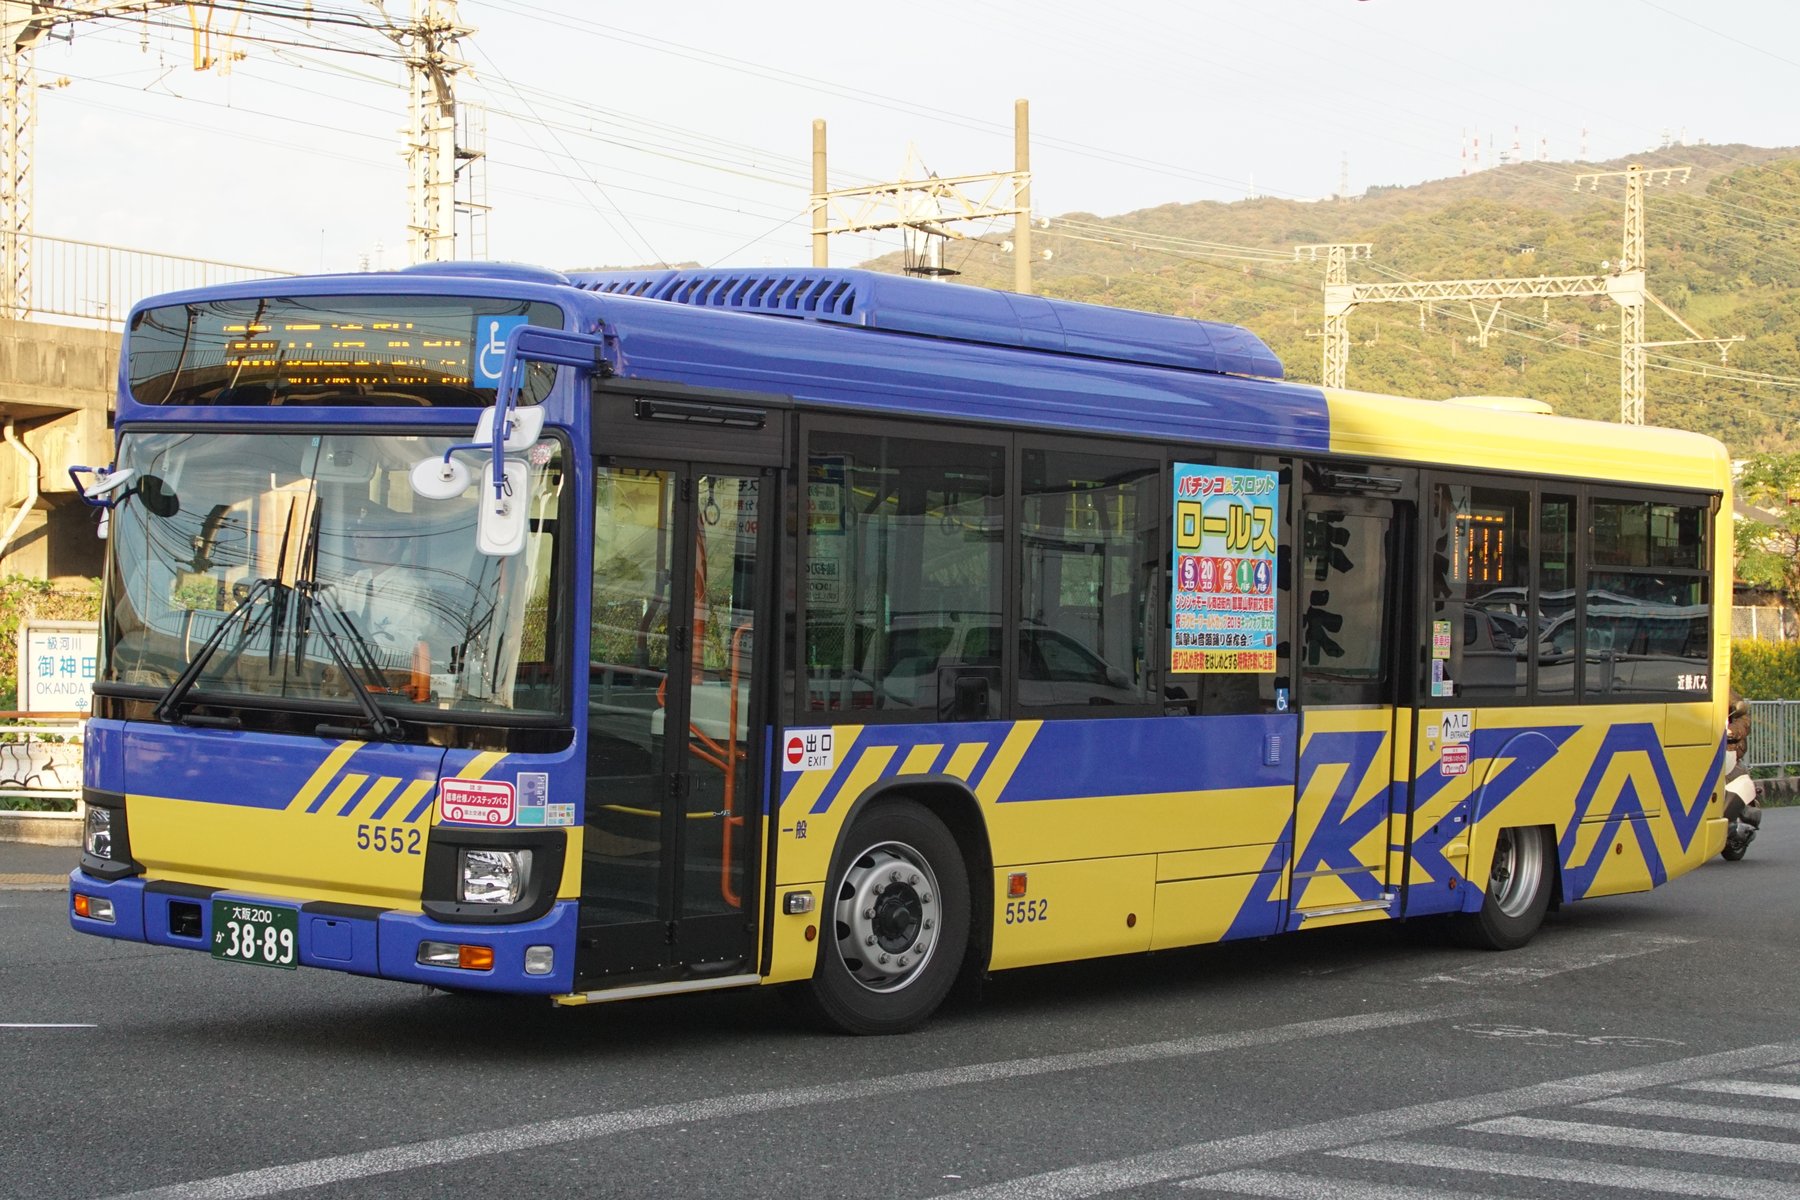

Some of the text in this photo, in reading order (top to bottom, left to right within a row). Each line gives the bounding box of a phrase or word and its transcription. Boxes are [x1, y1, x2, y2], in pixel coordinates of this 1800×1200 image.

[1179, 476, 1275, 496] パチンコ&スロット
[1177, 500, 1275, 554] ロールス
[1184, 559, 1266, 582] 5 20 2 1 4
[35, 636, 81, 650] 一級河川
[36, 682, 85, 694] OKANDA
[1678, 674, 1707, 690] 近鉄バス
[1452, 714, 1468, 728] 入口
[806, 734, 832, 752] 出口
[1450, 730, 1470, 740] ENTRANCE
[808, 756, 828, 766] EXIT
[782, 820, 807, 839] 一般
[357, 824, 422, 855] 5552
[1006, 899, 1048, 924] 5552
[226, 922, 294, 964] 38-89
